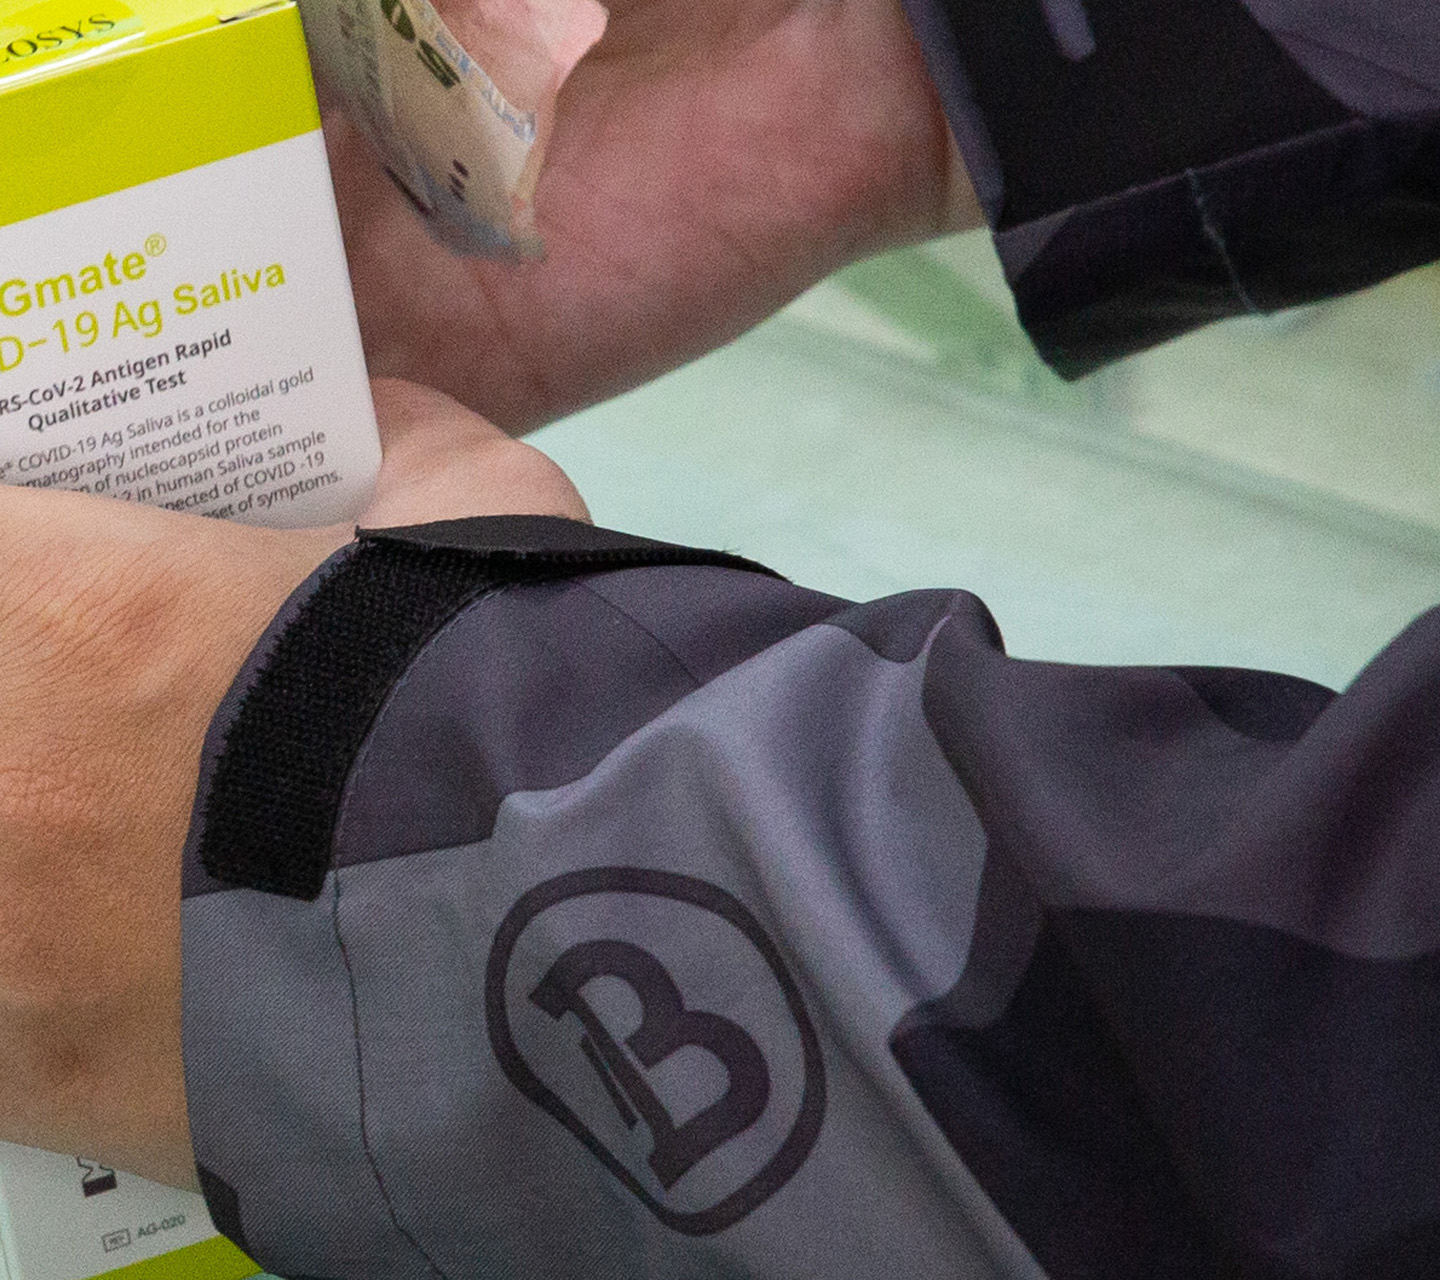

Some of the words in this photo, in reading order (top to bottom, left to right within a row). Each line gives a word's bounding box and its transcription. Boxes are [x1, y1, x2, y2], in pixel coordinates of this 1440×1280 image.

[111, 296, 165, 339] Ag
[172, 262, 287, 317] Saliva
[90, 349, 172, 390] Antigen
[175, 328, 233, 360] Rapid
[18, 436, 97, 472] COVID-19
[101, 430, 123, 449] Ag
[126, 414, 174, 440] Saliva
[177, 409, 191, 424] is
[194, 405, 205, 418] a
[208, 380, 275, 414] colloidal
[278, 366, 315, 395] gold
[27, 384, 141, 432] Qualitative
[145, 369, 188, 396] Test
[94, 473, 113, 493] of
[115, 440, 220, 486] nucleocapsid
[225, 423, 283, 455] protein
[129, 425, 202, 460] intended
[206, 419, 229, 436] for
[233, 409, 261, 427] the
[136, 487, 152, 502] in
[155, 467, 215, 496] human
[217, 452, 264, 476] Saliva
[267, 430, 327, 461] sample
[223, 479, 241, 495] of
[243, 460, 296, 490] COVID
[300, 451, 325, 470] -19
[237, 495, 254, 513] of
[256, 469, 343, 509] symptoms.
[527, 938, 771, 1192] B
